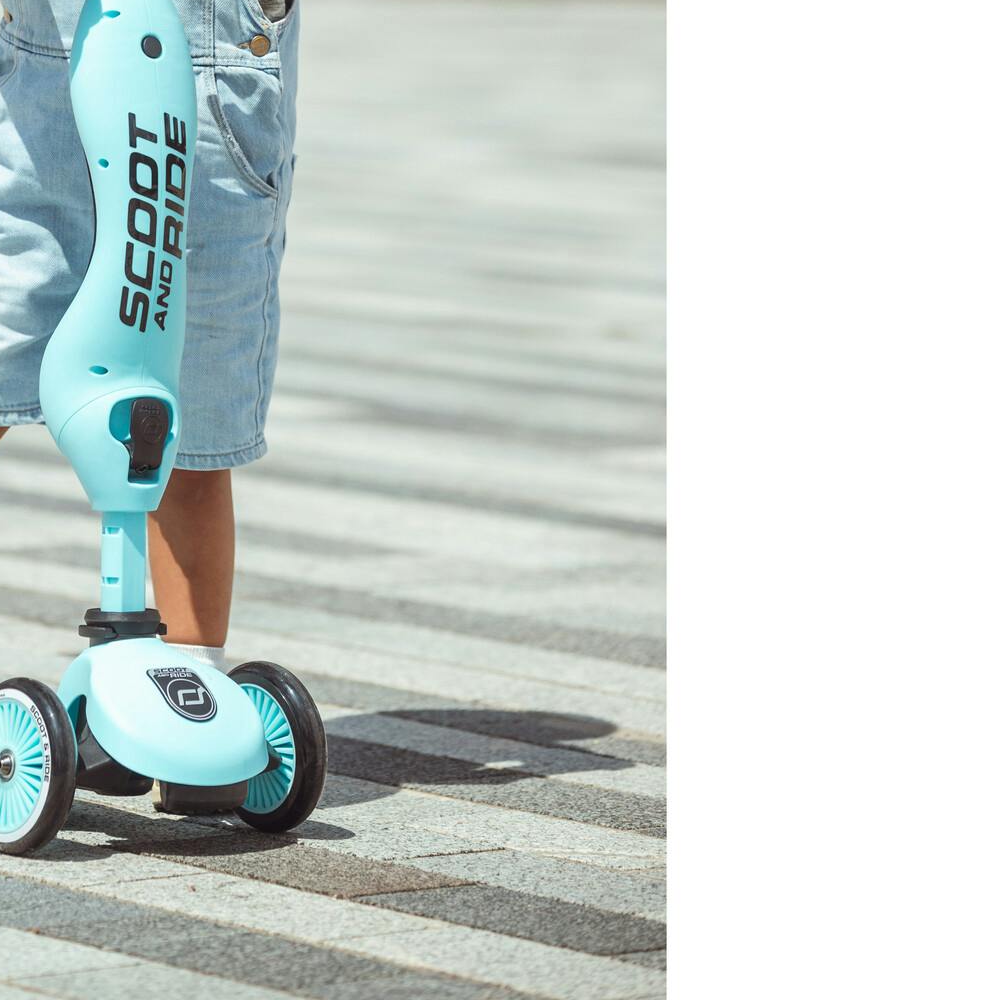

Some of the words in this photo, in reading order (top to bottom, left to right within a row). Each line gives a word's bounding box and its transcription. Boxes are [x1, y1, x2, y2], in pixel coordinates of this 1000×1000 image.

[119, 111, 158, 333] SCOOT
[162, 111, 187, 260] RIDE
[154, 260, 173, 331] AND
[29, 704, 47, 739] SCOOT
[43, 755, 51, 782] RIDE
